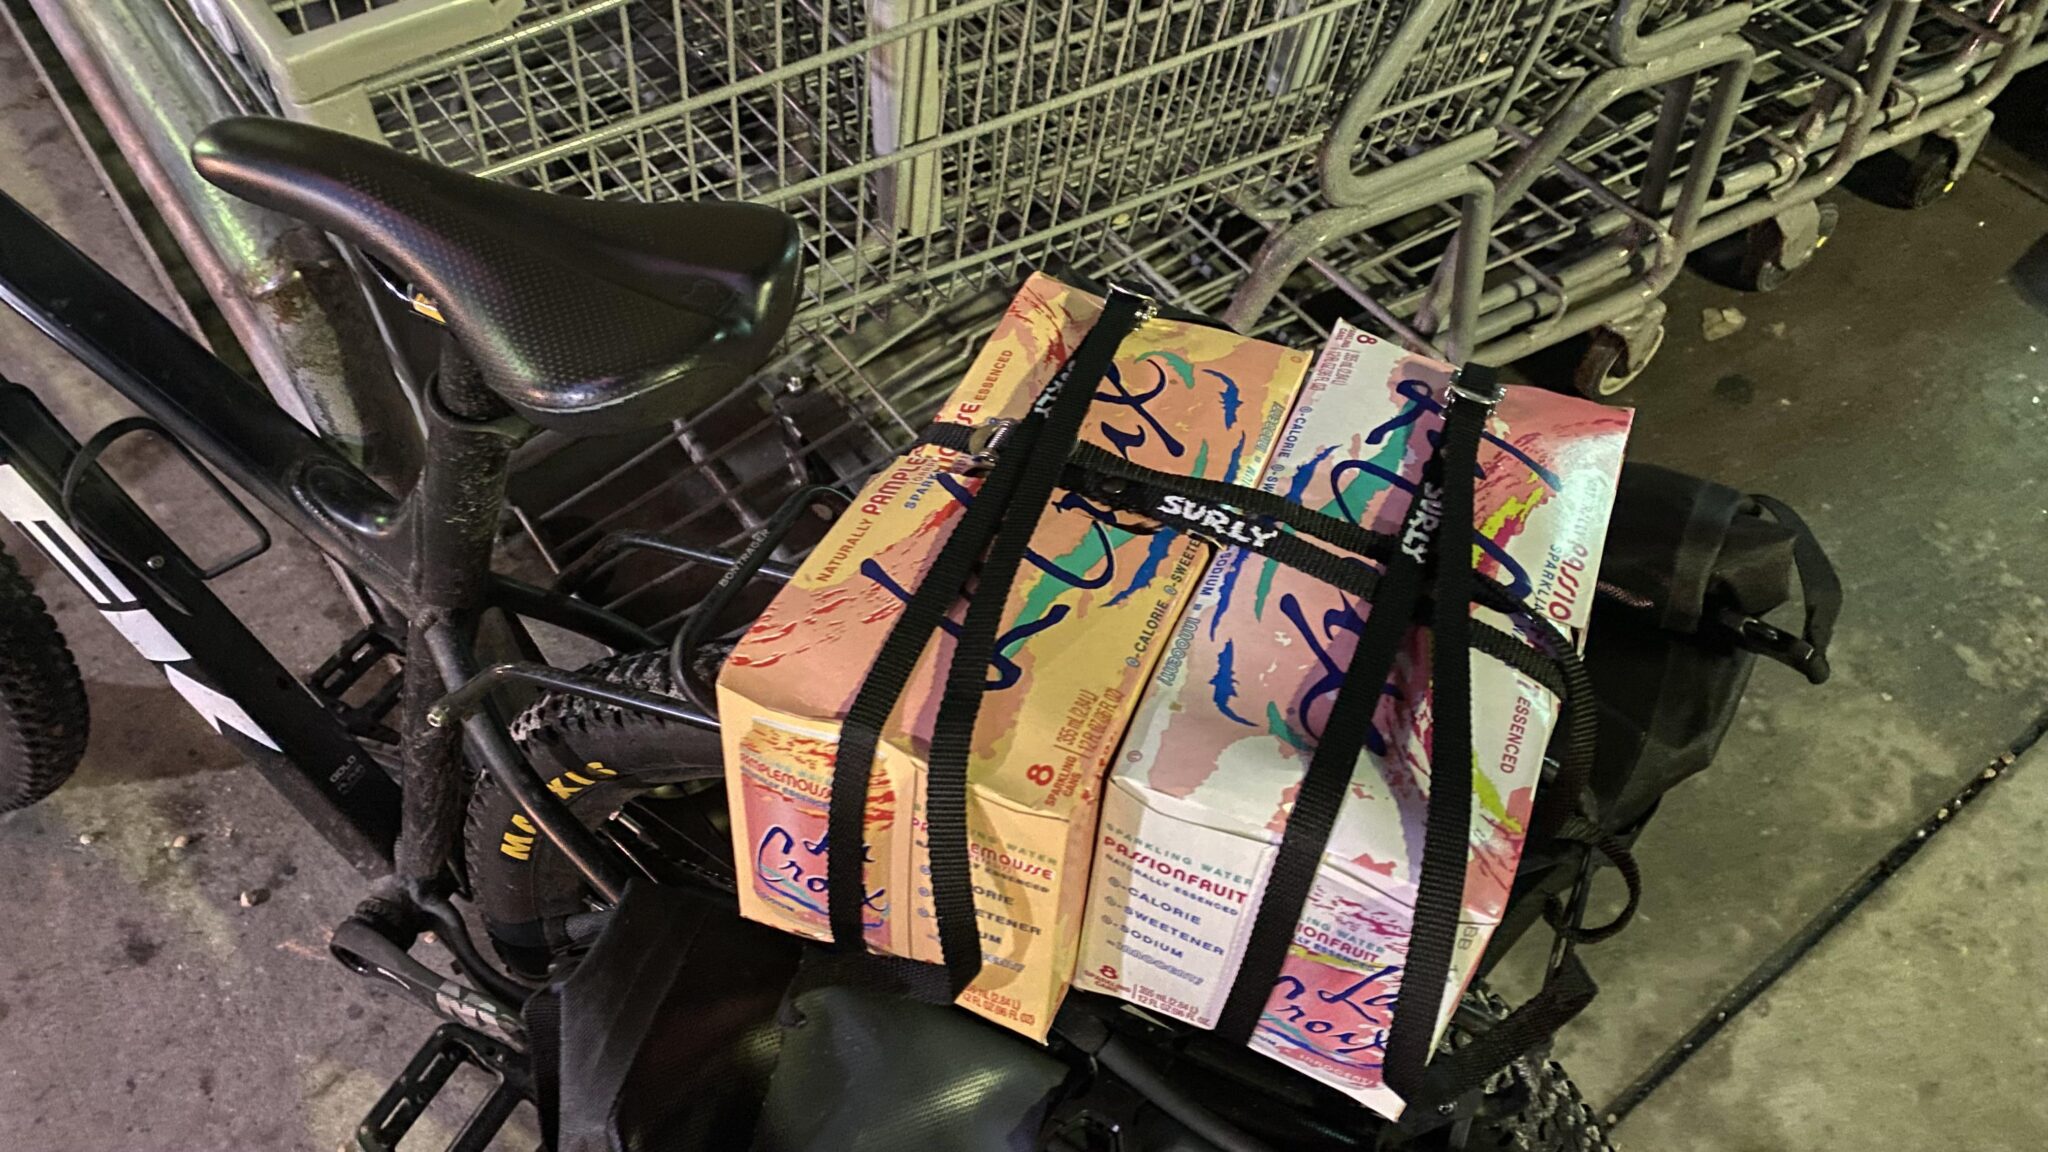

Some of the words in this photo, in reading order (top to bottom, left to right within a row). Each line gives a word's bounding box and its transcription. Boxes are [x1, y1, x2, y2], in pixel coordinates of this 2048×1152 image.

[1357, 334, 1377, 345] 8
[816, 517, 873, 582] NATURALLY
[975, 349, 1013, 402] ESSENCED
[904, 472, 938, 509] SPARK
[1157, 495, 1278, 548] SURLY
[1401, 481, 1444, 566] SURLY
[1163, 538, 1202, 596] 0-SWEETE
[1500, 696, 1531, 774] ESSENCED
[1026, 764, 1055, 787] 8
[1044, 755, 1078, 806] SPARKLING
[1103, 835, 1249, 905] PASSIONFRUIT
[1105, 822, 1193, 866] SPARKLING
[1201, 863, 1254, 887] WATER
[1105, 853, 1171, 889] NATURALLY
[1173, 885, 1239, 917] ESSENCED
[1297, 922, 1379, 963] IONFRUIT
[1099, 964, 1119, 980] 8
